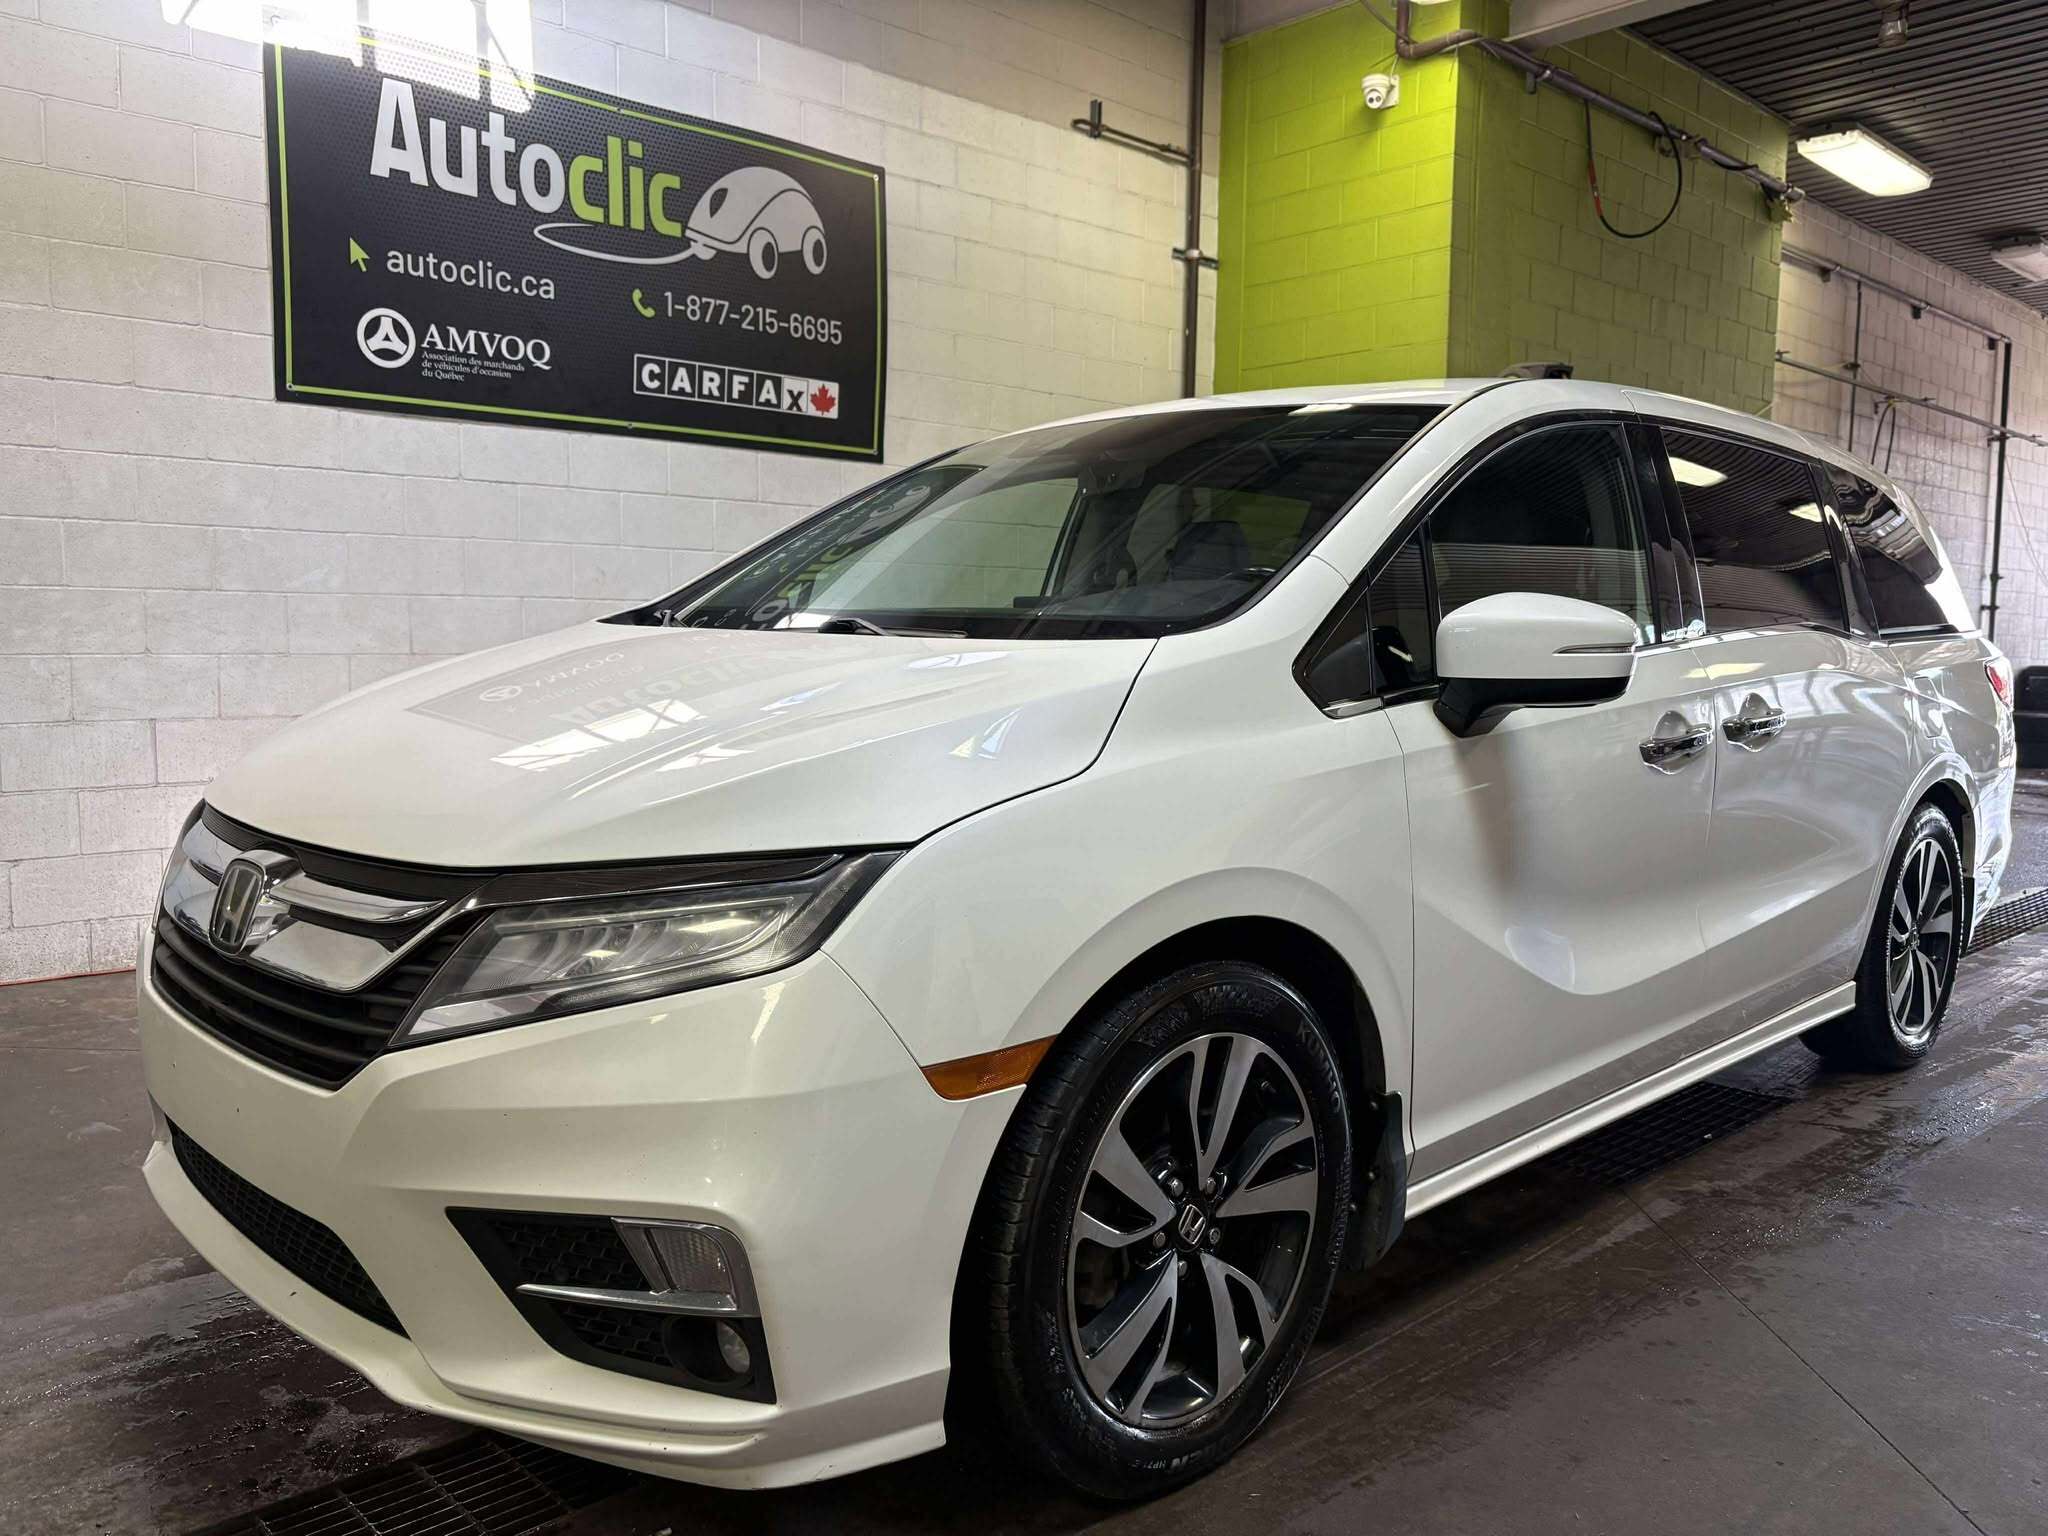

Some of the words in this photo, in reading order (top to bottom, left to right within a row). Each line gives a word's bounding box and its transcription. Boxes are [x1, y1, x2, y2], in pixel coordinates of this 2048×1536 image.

[370, 77, 682, 238] Autoclic
[386, 250, 555, 300] autoclic.ca
[664, 291, 843, 345] 1-877-215-6695
[420, 323, 552, 370] AMVOQ
[421, 360, 433, 368] de
[433, 361, 471, 374] véhicules
[471, 366, 512, 379] d'occasion
[422, 351, 467, 364] Association
[468, 357, 482, 366] des
[483, 360, 525, 372] marchands
[421, 369, 433, 377] du
[434, 369, 465, 381] Québec
[640, 363, 803, 413] CARFAX
